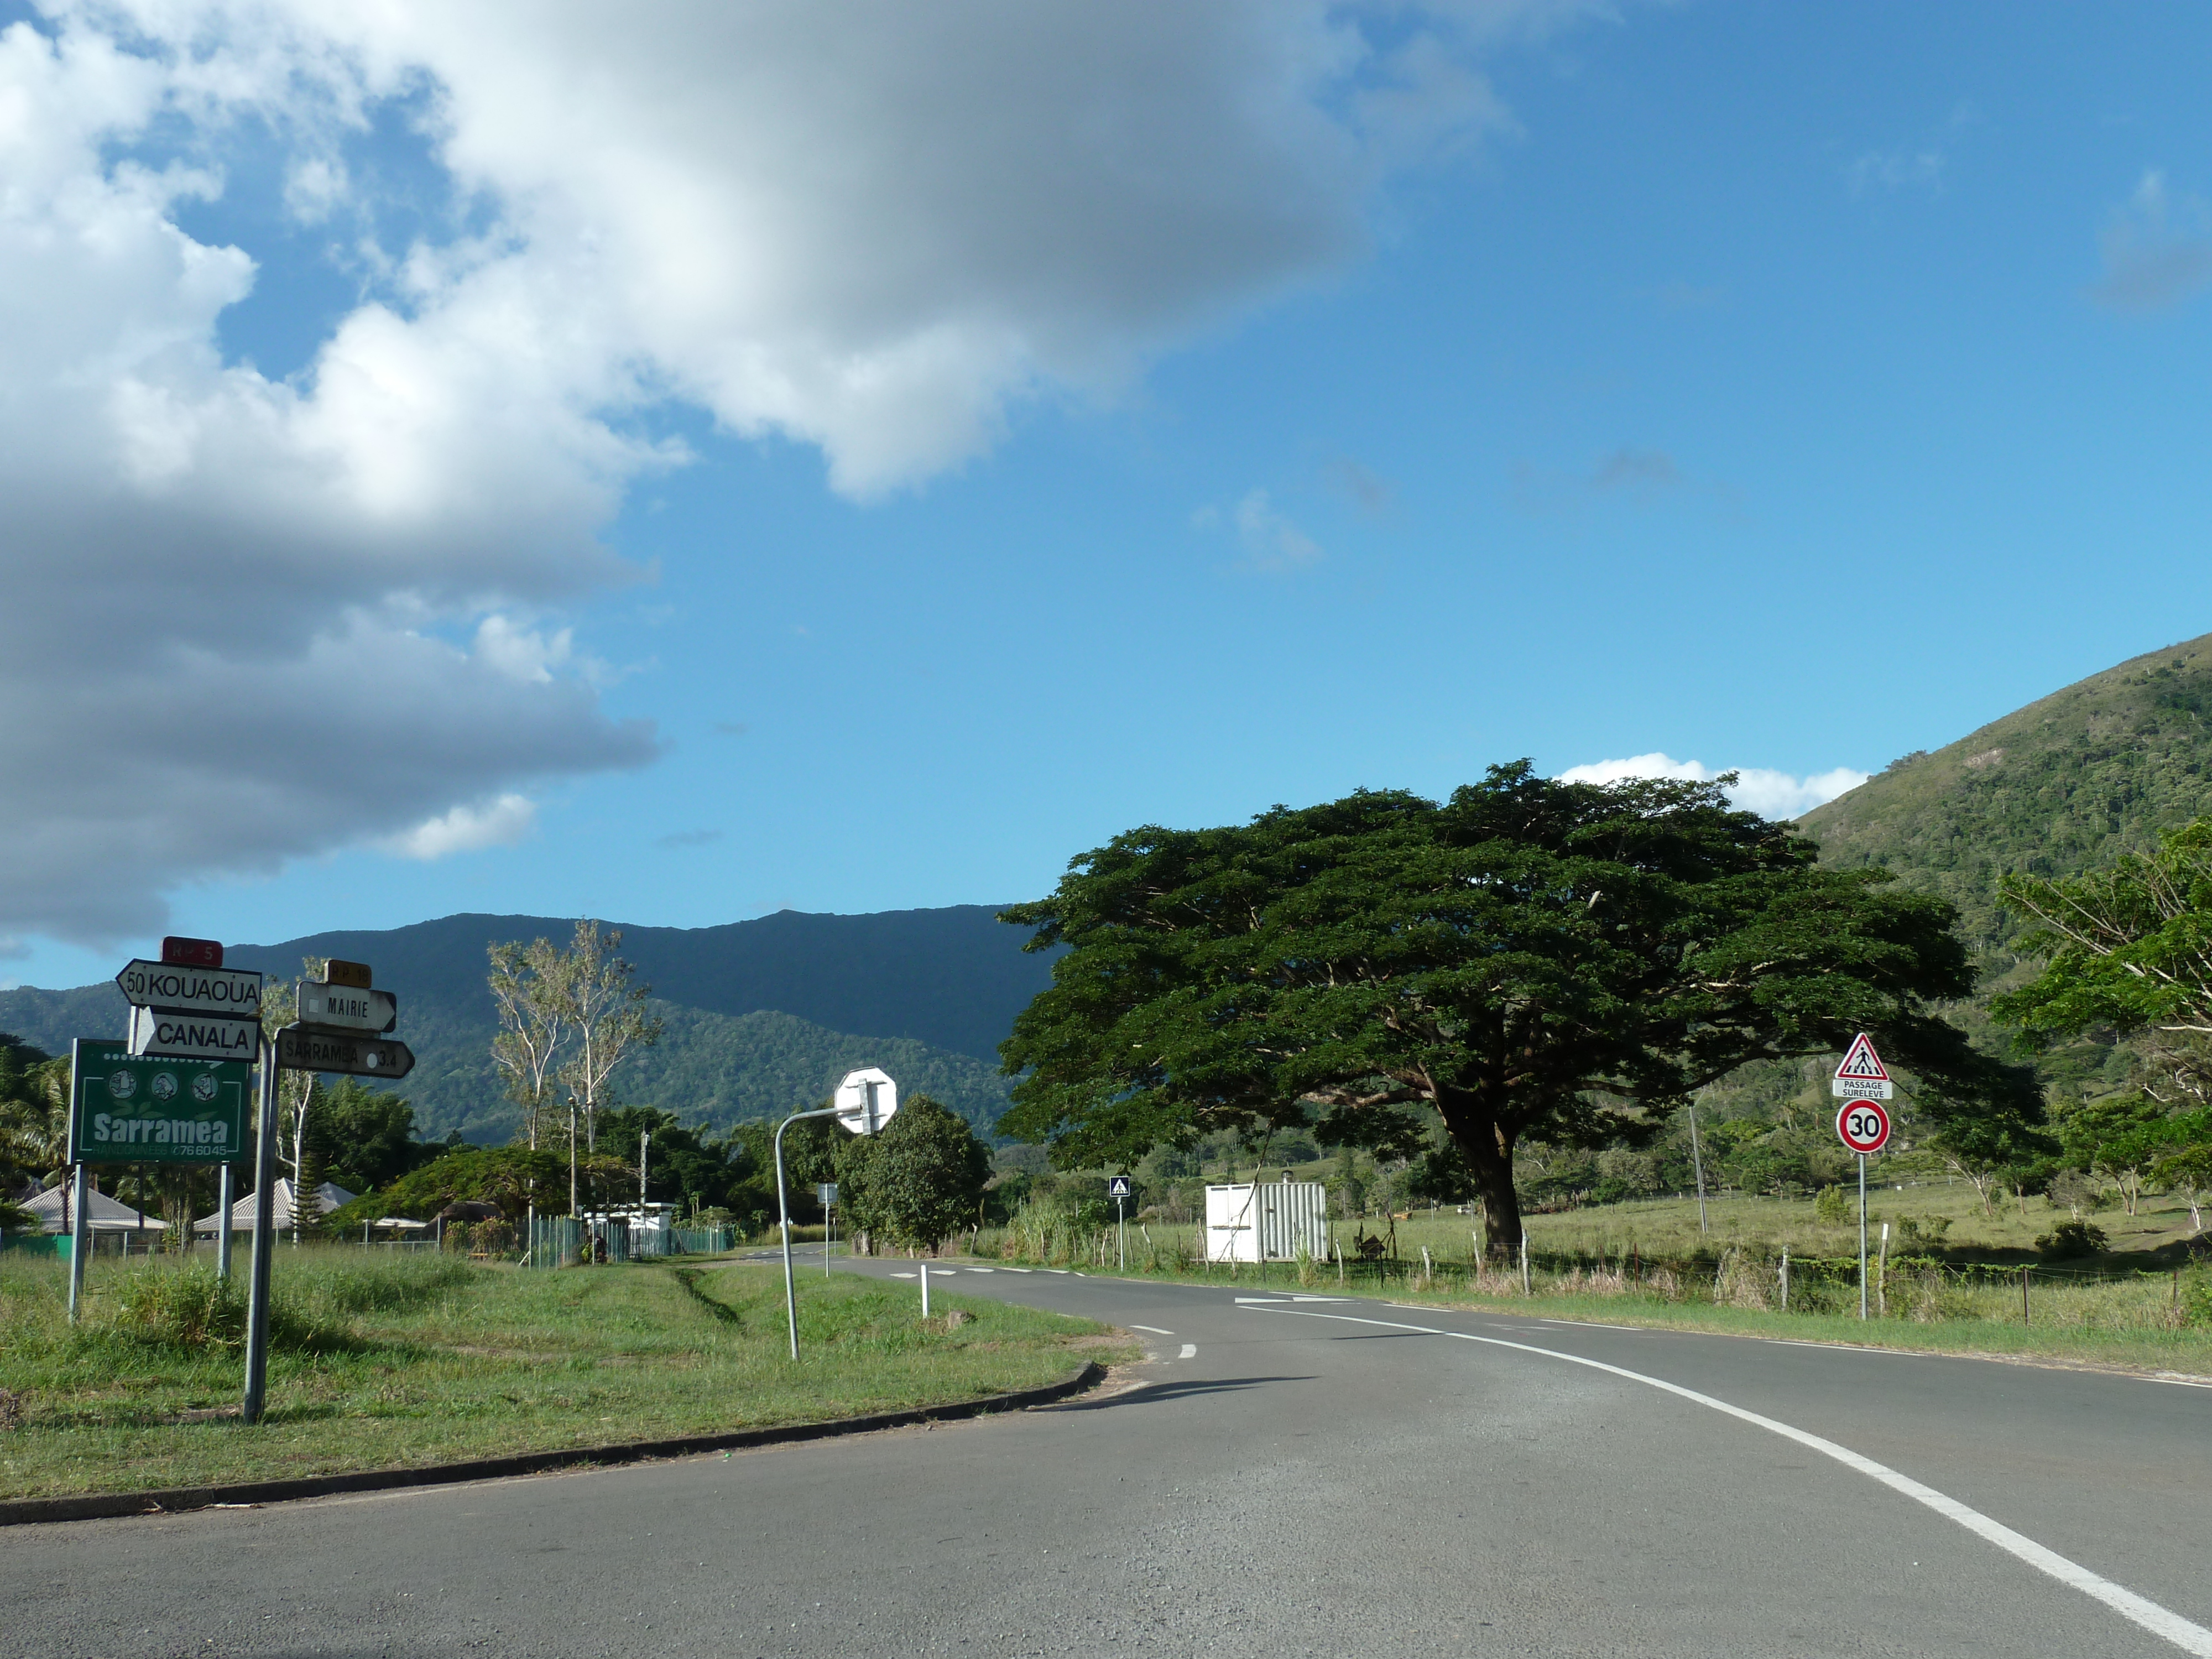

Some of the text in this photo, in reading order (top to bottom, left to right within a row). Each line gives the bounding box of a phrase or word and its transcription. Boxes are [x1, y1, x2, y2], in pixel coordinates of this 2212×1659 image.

[205, 946, 213, 960] 5
[127, 972, 258, 1004] 50 KOUAOUA
[328, 997, 368, 1018] MAIRIE
[157, 1022, 249, 1050] CANALA
[286, 1040, 397, 1068] SARRAMEA 3.4
[1843, 1089, 1884, 1098] SURELEVE
[1844, 1081, 1882, 1089] PASSAGE
[1849, 1114, 1880, 1138] 30
